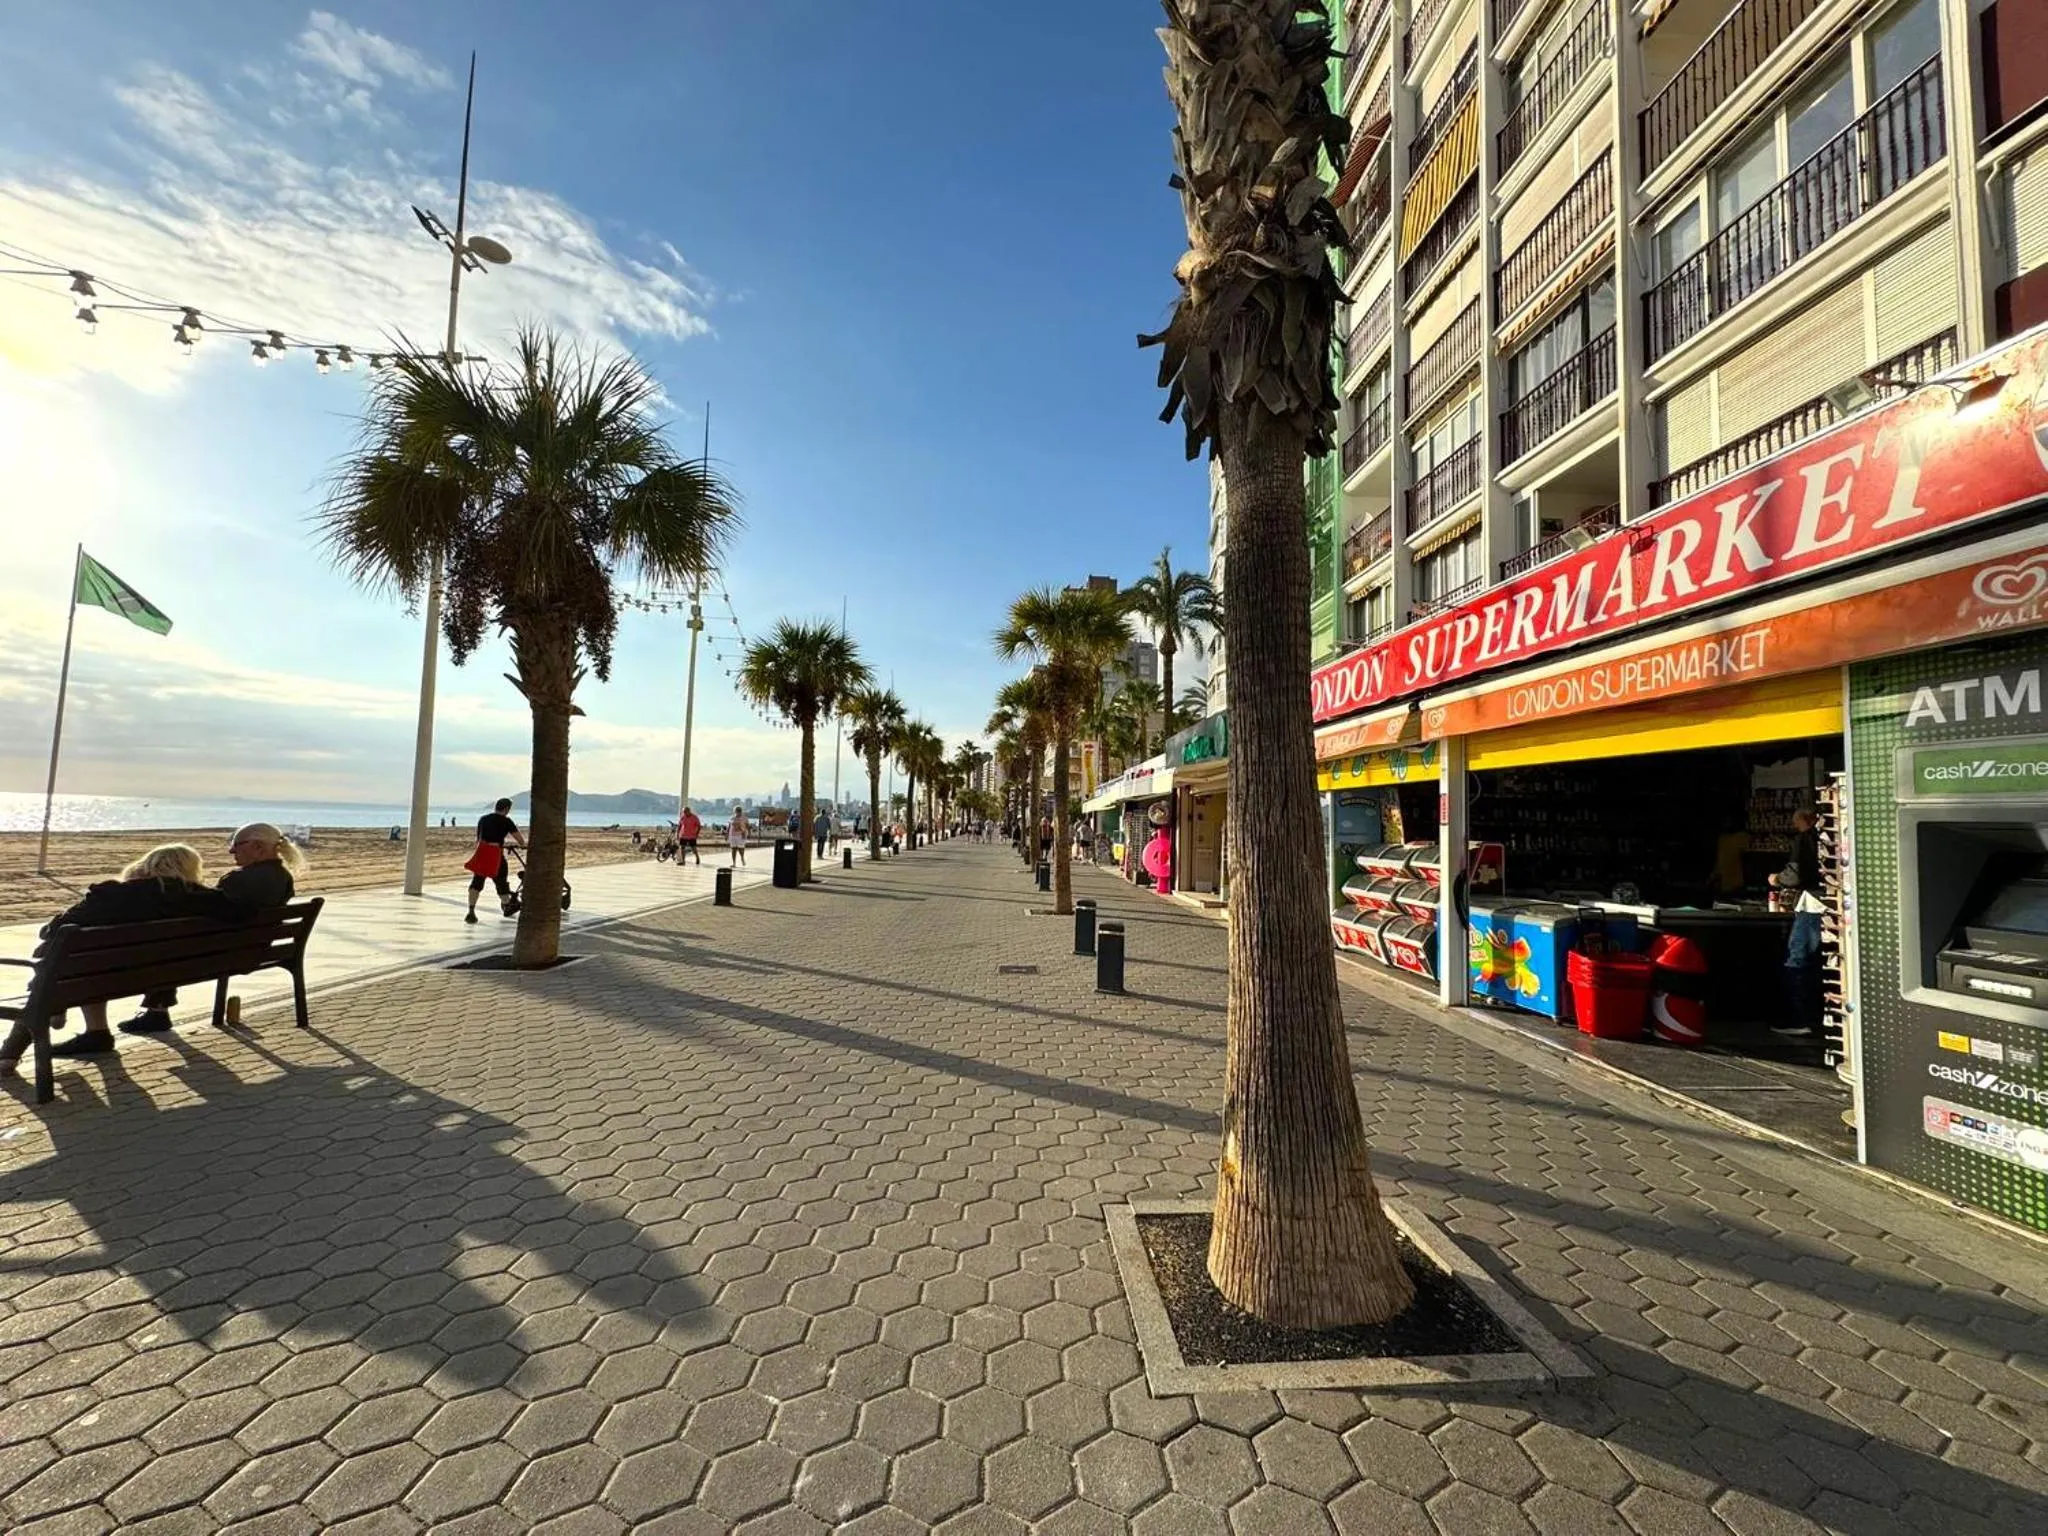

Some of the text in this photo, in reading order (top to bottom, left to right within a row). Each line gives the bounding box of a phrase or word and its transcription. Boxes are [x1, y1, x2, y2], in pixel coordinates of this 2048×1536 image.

[1311, 408, 1932, 716] ONDON SUPERMARKET
[1507, 628, 1771, 720] LONDON SUPERMARKET
[1904, 669, 2041, 728] ATM
